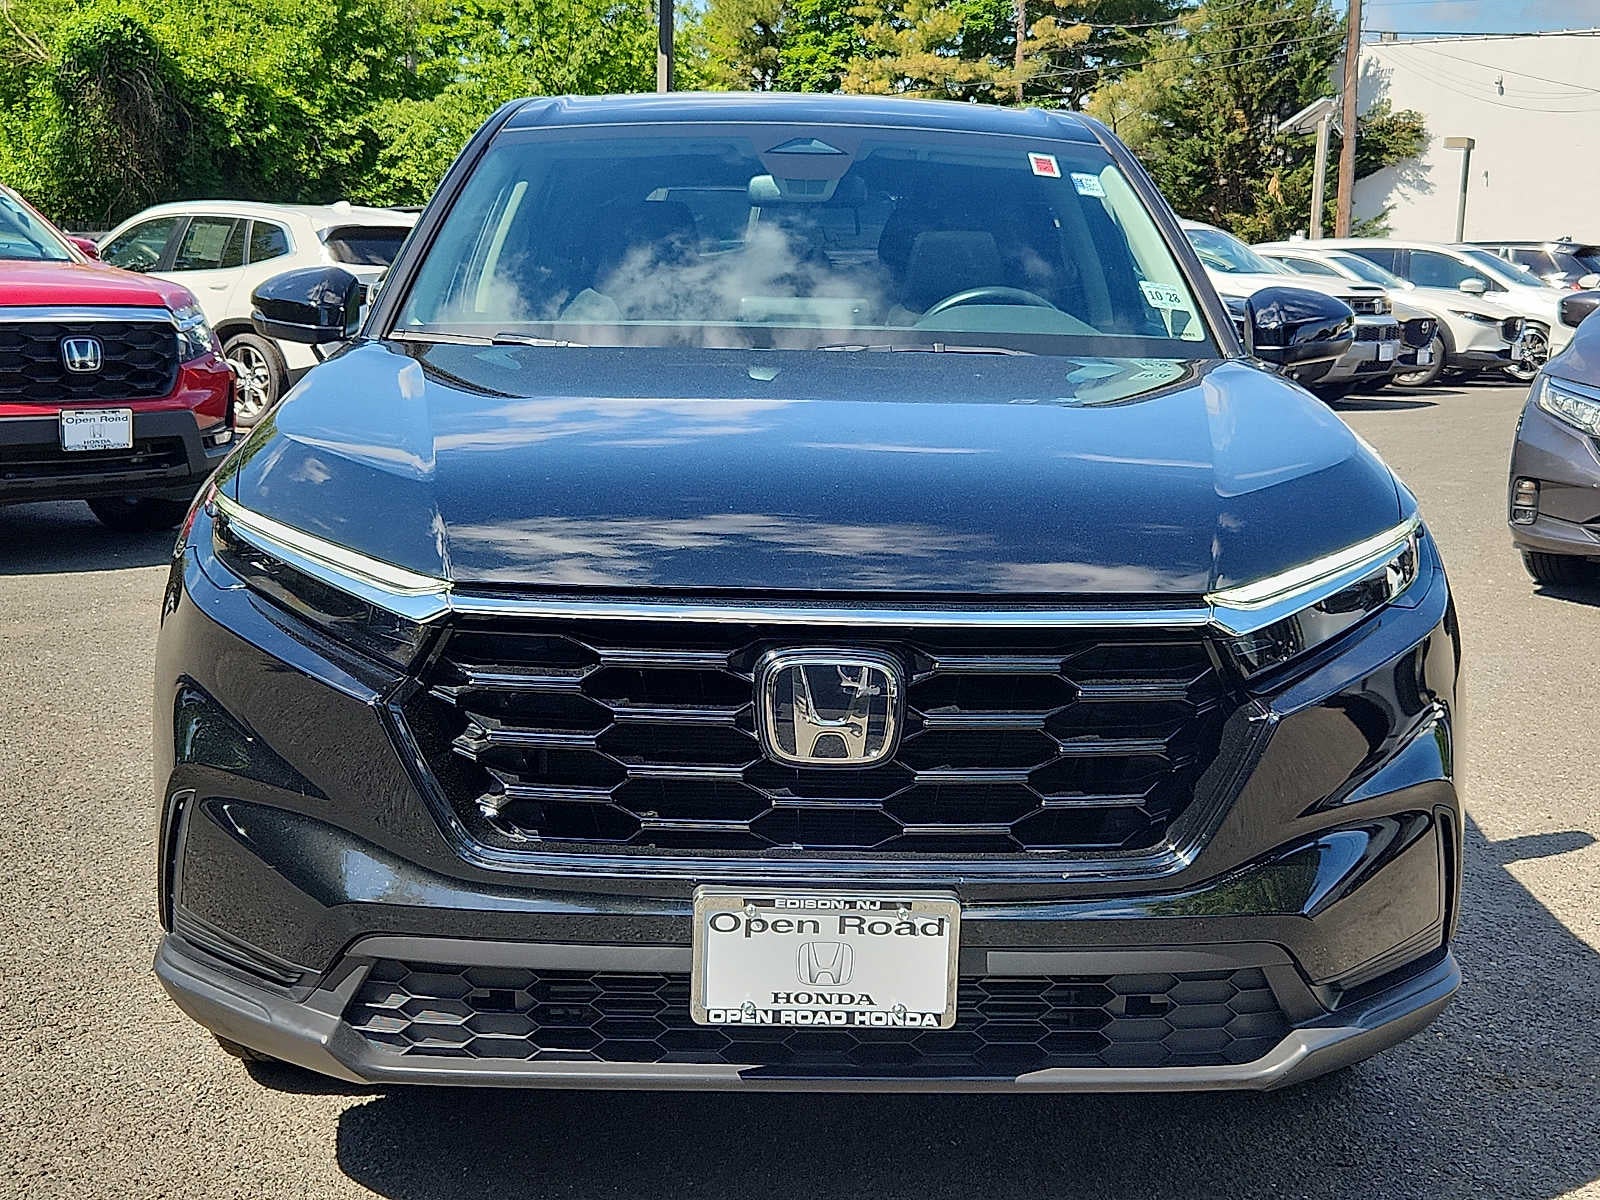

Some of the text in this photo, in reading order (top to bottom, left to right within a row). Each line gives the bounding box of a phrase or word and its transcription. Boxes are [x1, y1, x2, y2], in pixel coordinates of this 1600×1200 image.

[1148, 290, 1163, 301] 10
[65, 416, 96, 425] Open
[856, 900, 880, 910] NJ
[709, 912, 945, 938] Open Road
[771, 991, 878, 1006] HONDA
[708, 1009, 939, 1027] OPEN ROAD HONDA
